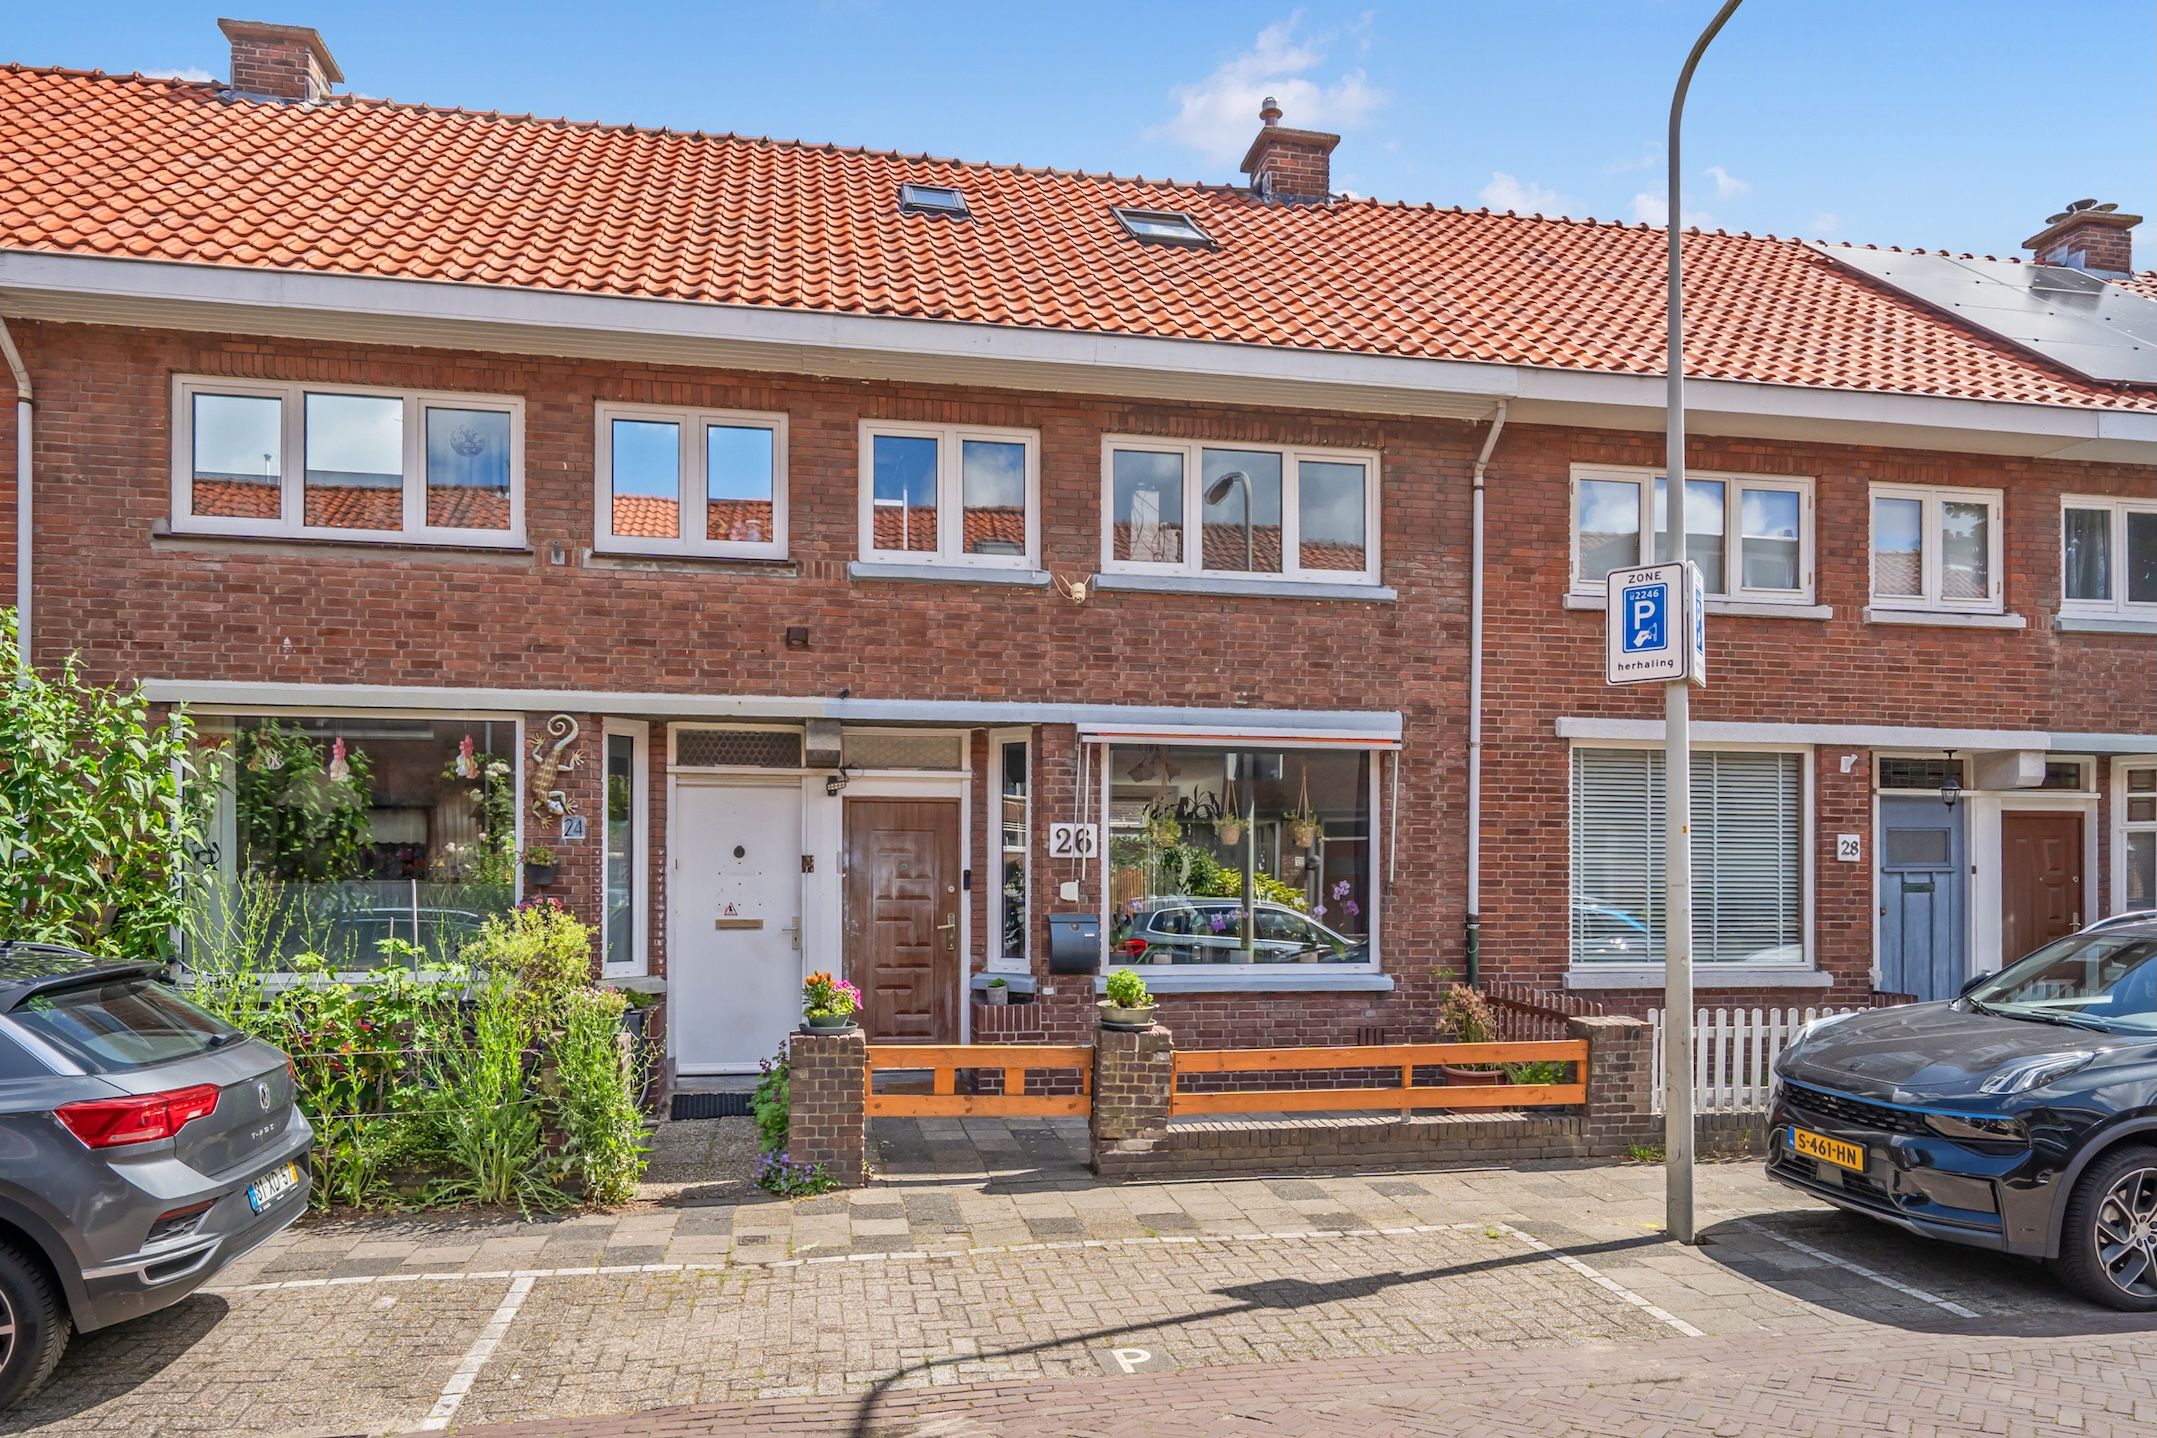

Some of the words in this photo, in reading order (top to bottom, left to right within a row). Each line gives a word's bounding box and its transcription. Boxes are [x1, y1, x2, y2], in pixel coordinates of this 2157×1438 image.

[1628, 571, 1662, 584] ZONE
[1635, 589, 1659, 600] 2246
[1634, 600, 1656, 630] P
[1618, 659, 1674, 671] herhaling
[564, 818, 583, 836] 24
[1056, 828, 1092, 853] 26
[1841, 840, 1859, 856] 28
[1798, 1133, 1856, 1166] S-461-HN
[1111, 1349, 1151, 1373] P
